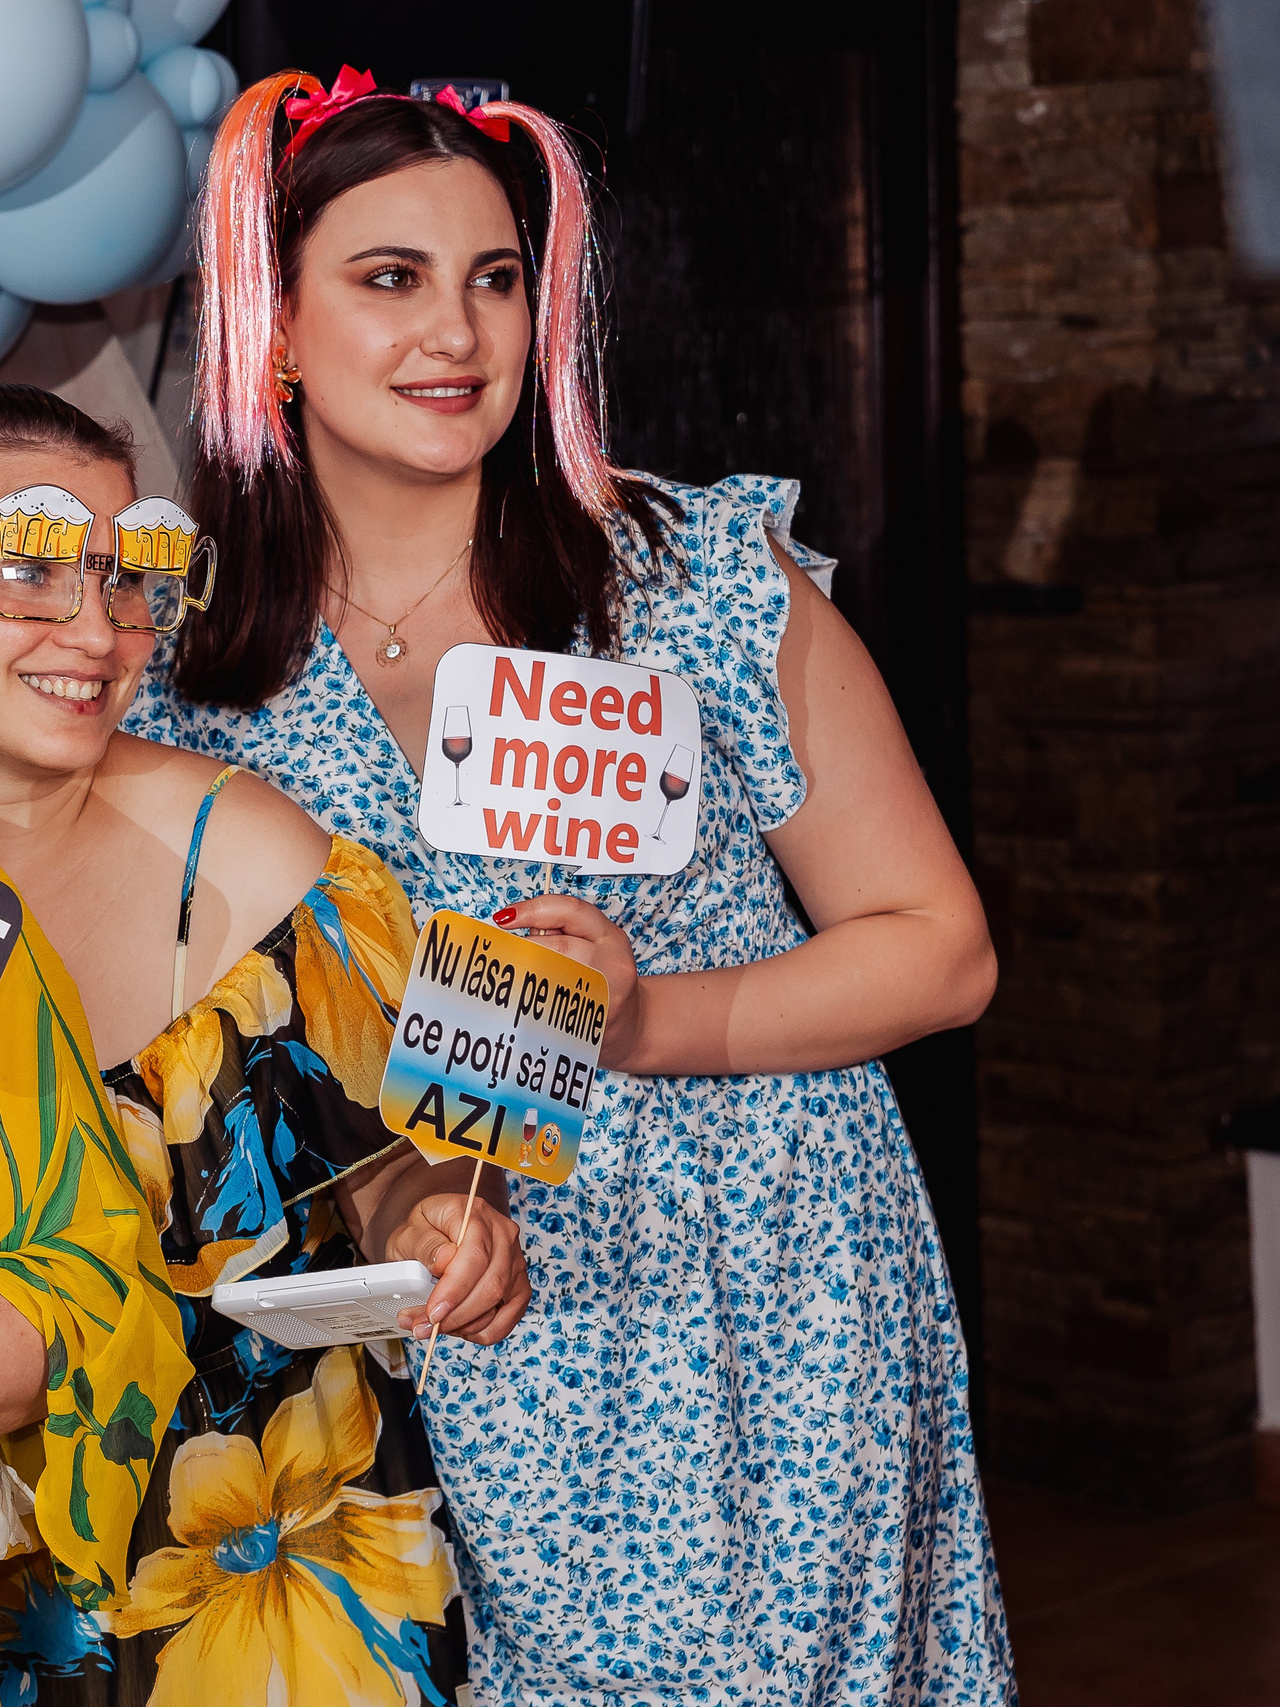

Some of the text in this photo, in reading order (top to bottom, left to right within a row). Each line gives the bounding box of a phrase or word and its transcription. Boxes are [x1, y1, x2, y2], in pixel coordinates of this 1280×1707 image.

[85, 554, 114, 571] BEER
[489, 656, 662, 737] Need
[490, 737, 646, 802] more
[483, 797, 639, 863] wine
[419, 919, 605, 1046] Nu lăsa pe mâine
[403, 1012, 443, 1056] ce
[516, 1046, 549, 1094] să
[550, 1054, 594, 1112] BEI
[405, 1082, 507, 1157] AZI
